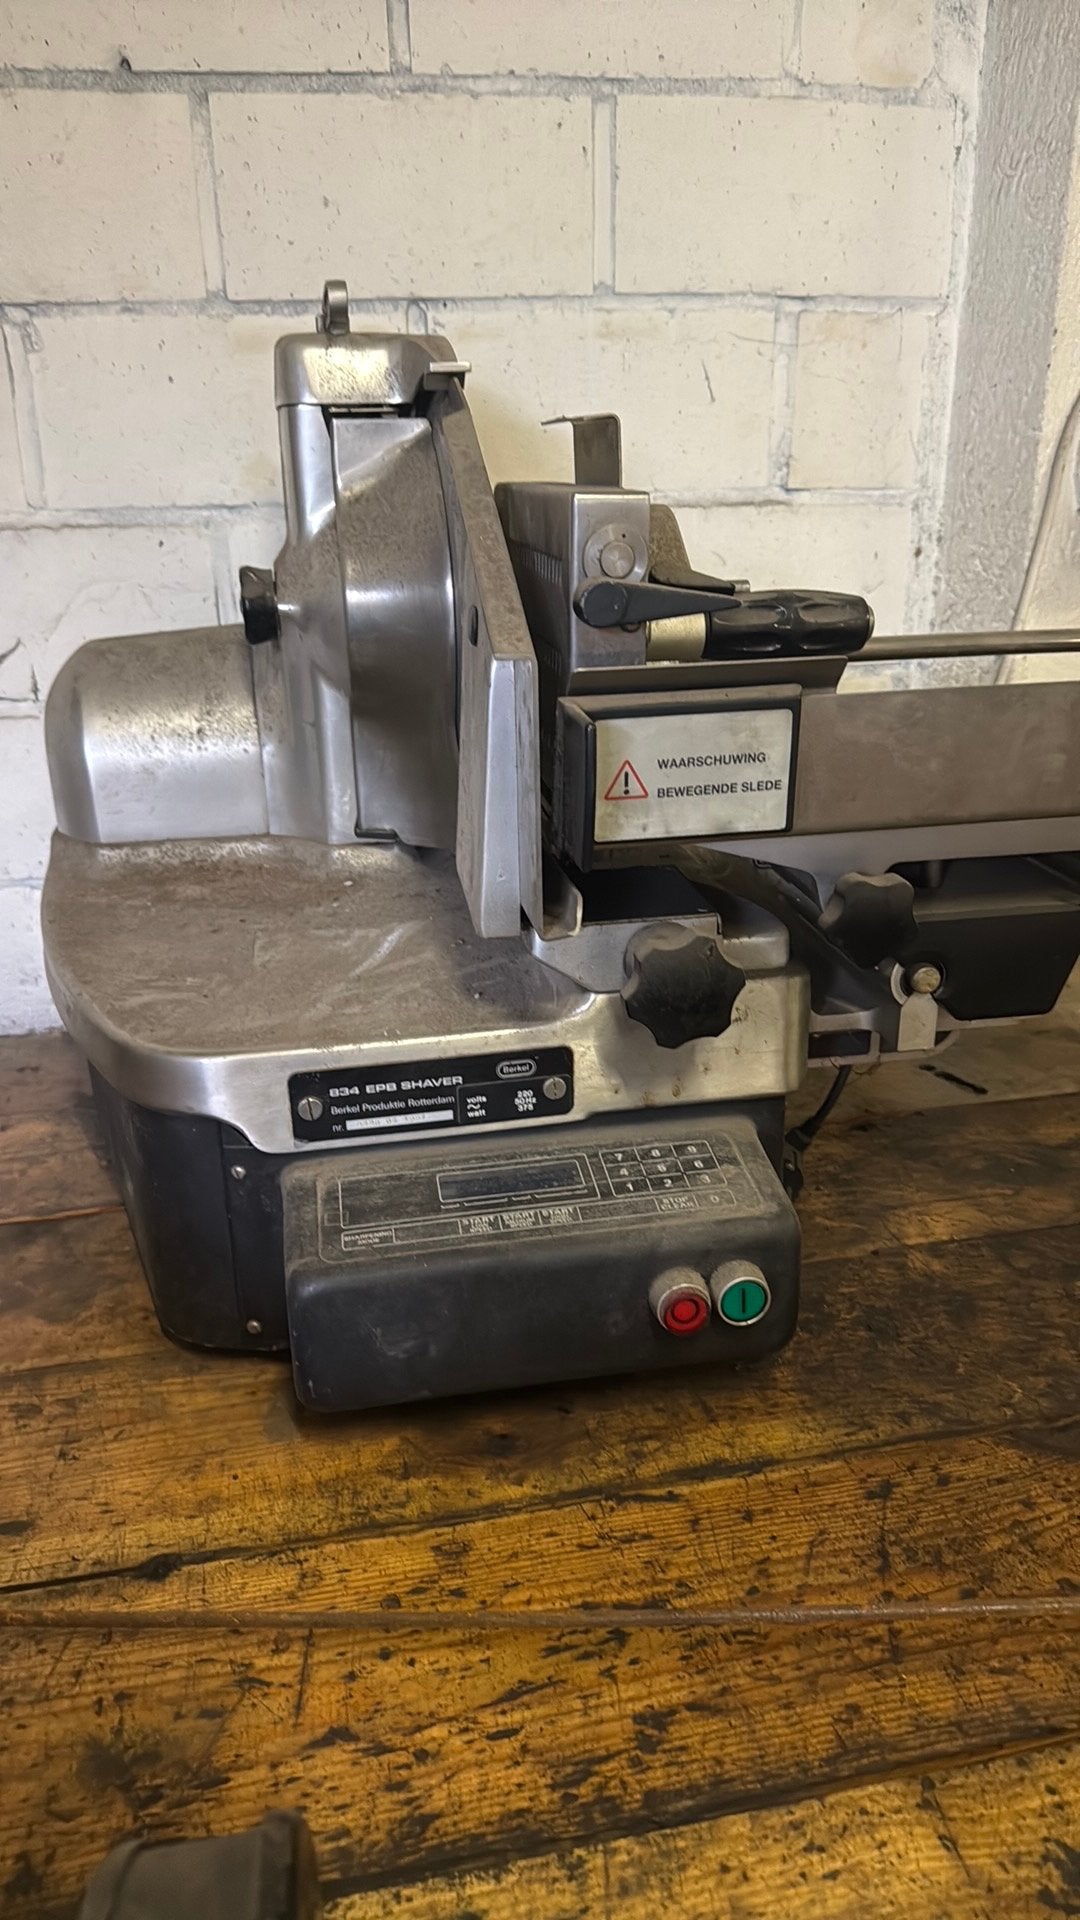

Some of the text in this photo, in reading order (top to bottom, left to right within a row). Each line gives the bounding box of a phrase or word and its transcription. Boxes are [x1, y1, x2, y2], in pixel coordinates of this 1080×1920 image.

[657, 752, 766, 769] WAARSCHUWING
[657, 779, 782, 798] BEWEGENDE SLEDE
[502, 1063, 530, 1074] Berkel
[329, 1075, 463, 1097] 834 EPB SHAVER
[466, 1095, 487, 1104] volts
[331, 1095, 455, 1115] Berkel Produktie Rotterdam
[467, 1109, 486, 1118] watt
[614, 1152, 623, 1162] 7
[694, 1159, 704, 1169] 6
[619, 1167, 629, 1176] 4
[626, 1182, 634, 1192] 1
[663, 1178, 674, 1188] 2
